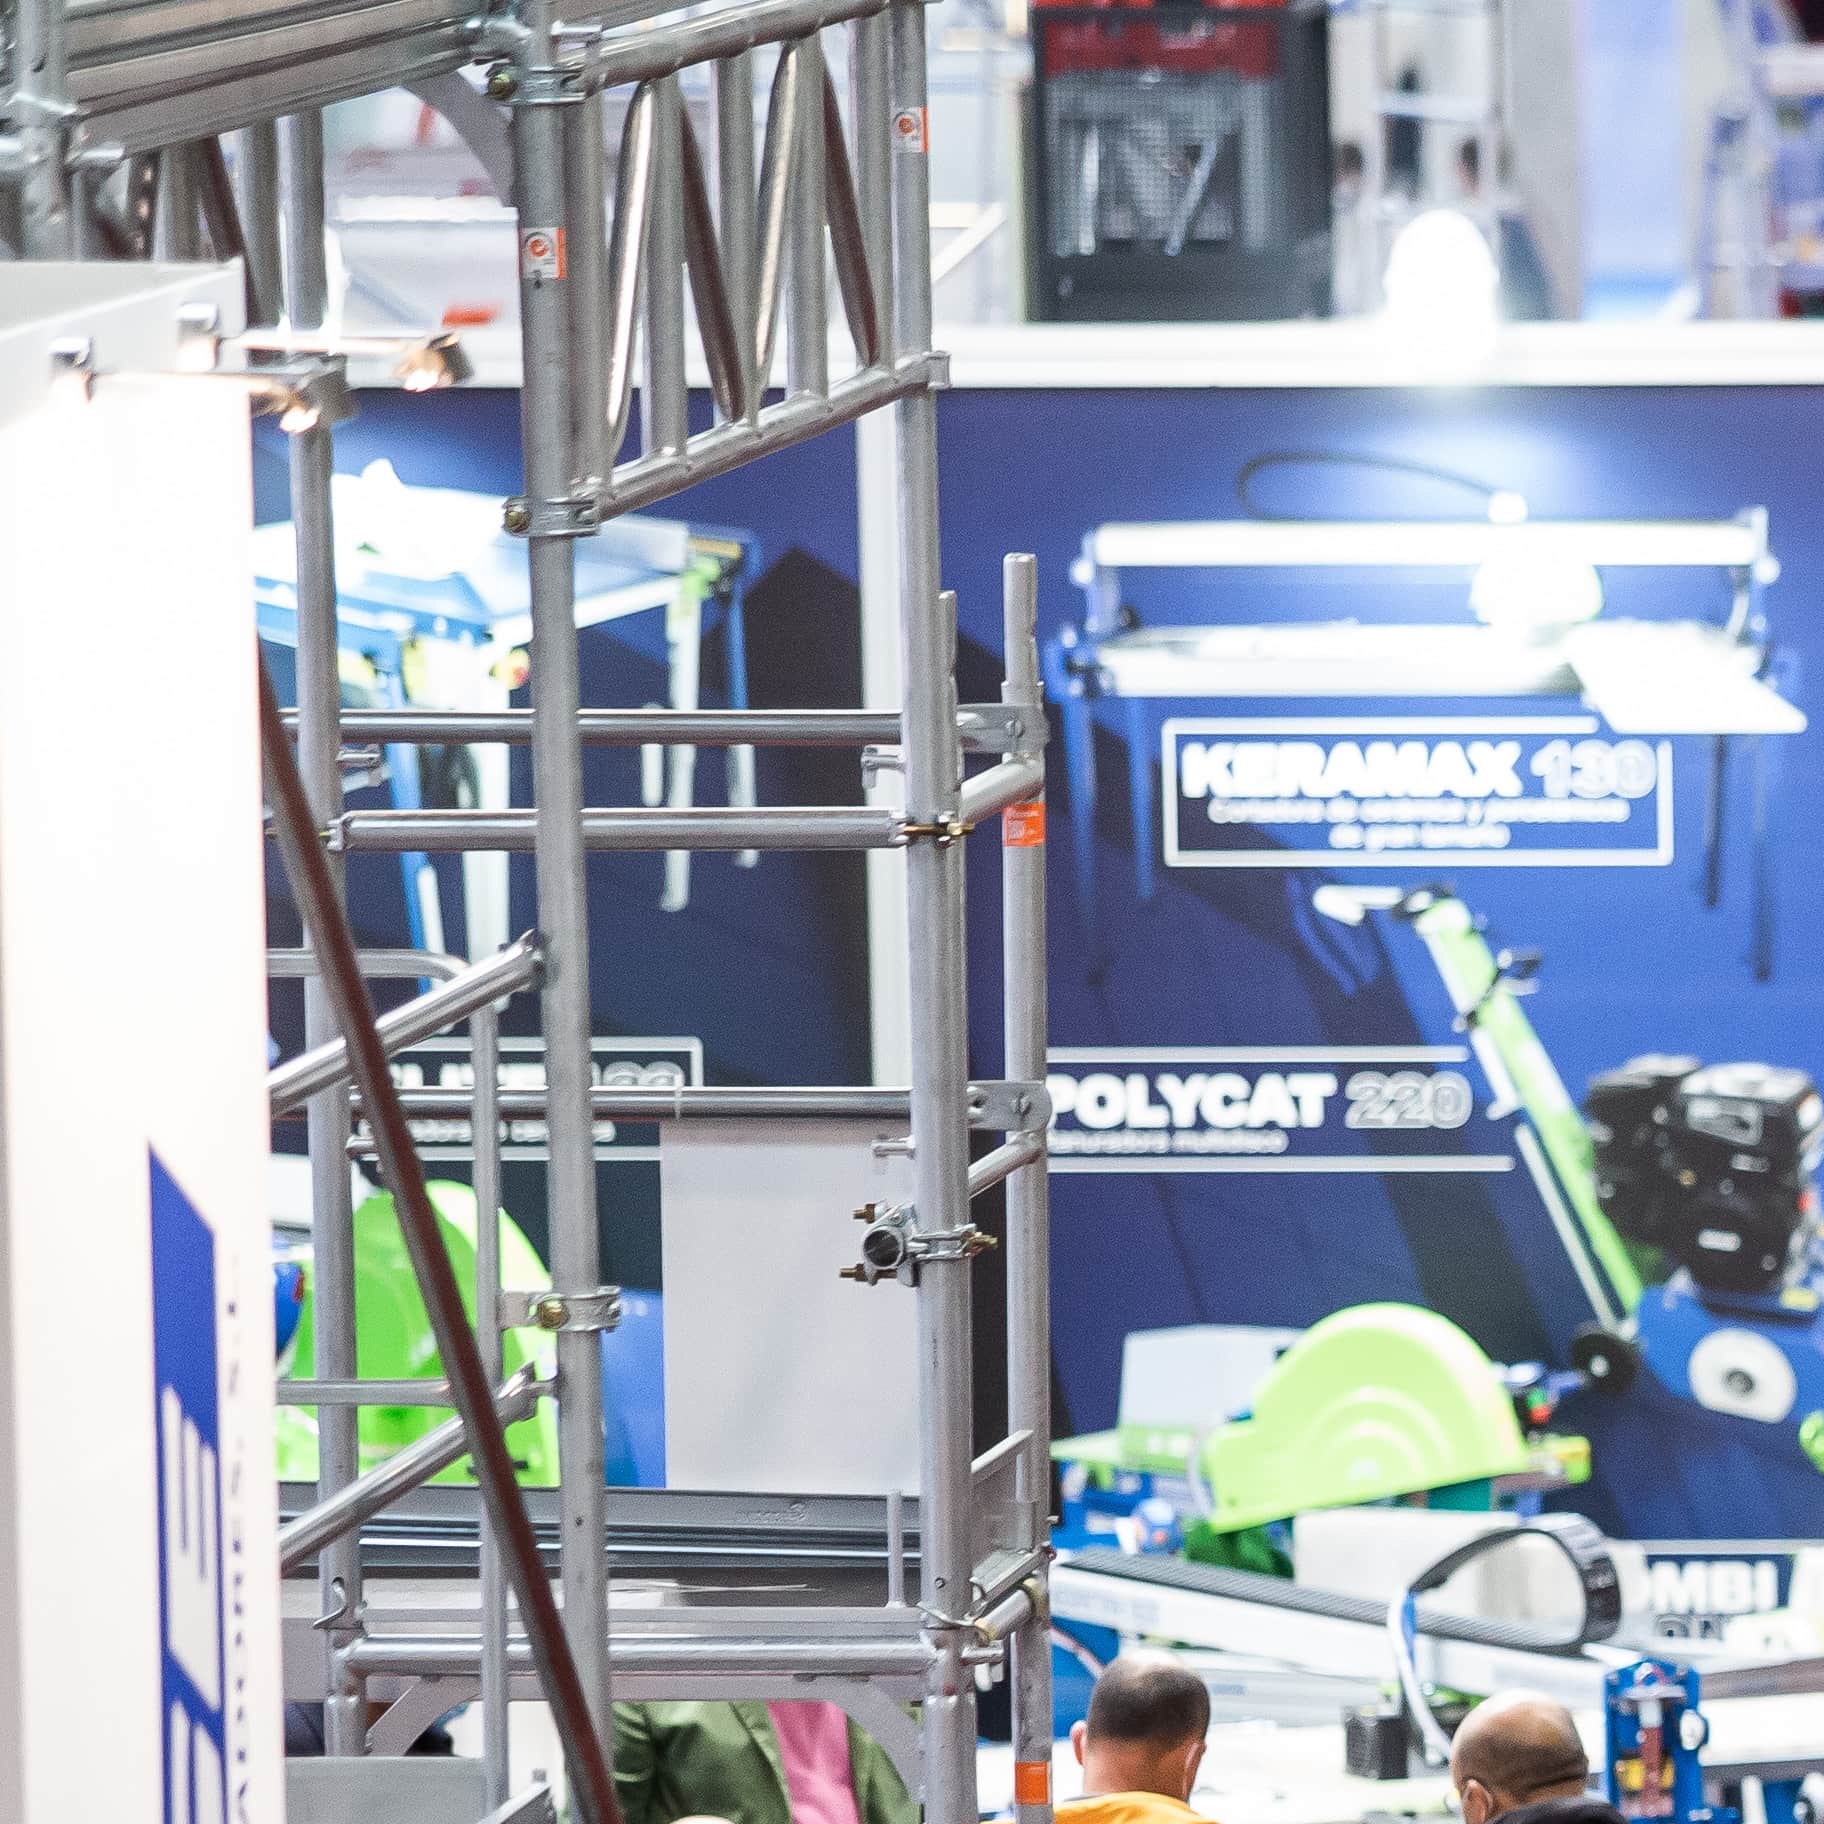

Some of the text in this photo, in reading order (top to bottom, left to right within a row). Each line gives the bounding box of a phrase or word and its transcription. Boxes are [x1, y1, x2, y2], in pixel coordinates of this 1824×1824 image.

[1181, 740, 1523, 799] KERAMAX
[1047, 1071, 1473, 1129] POLYCAT 220
